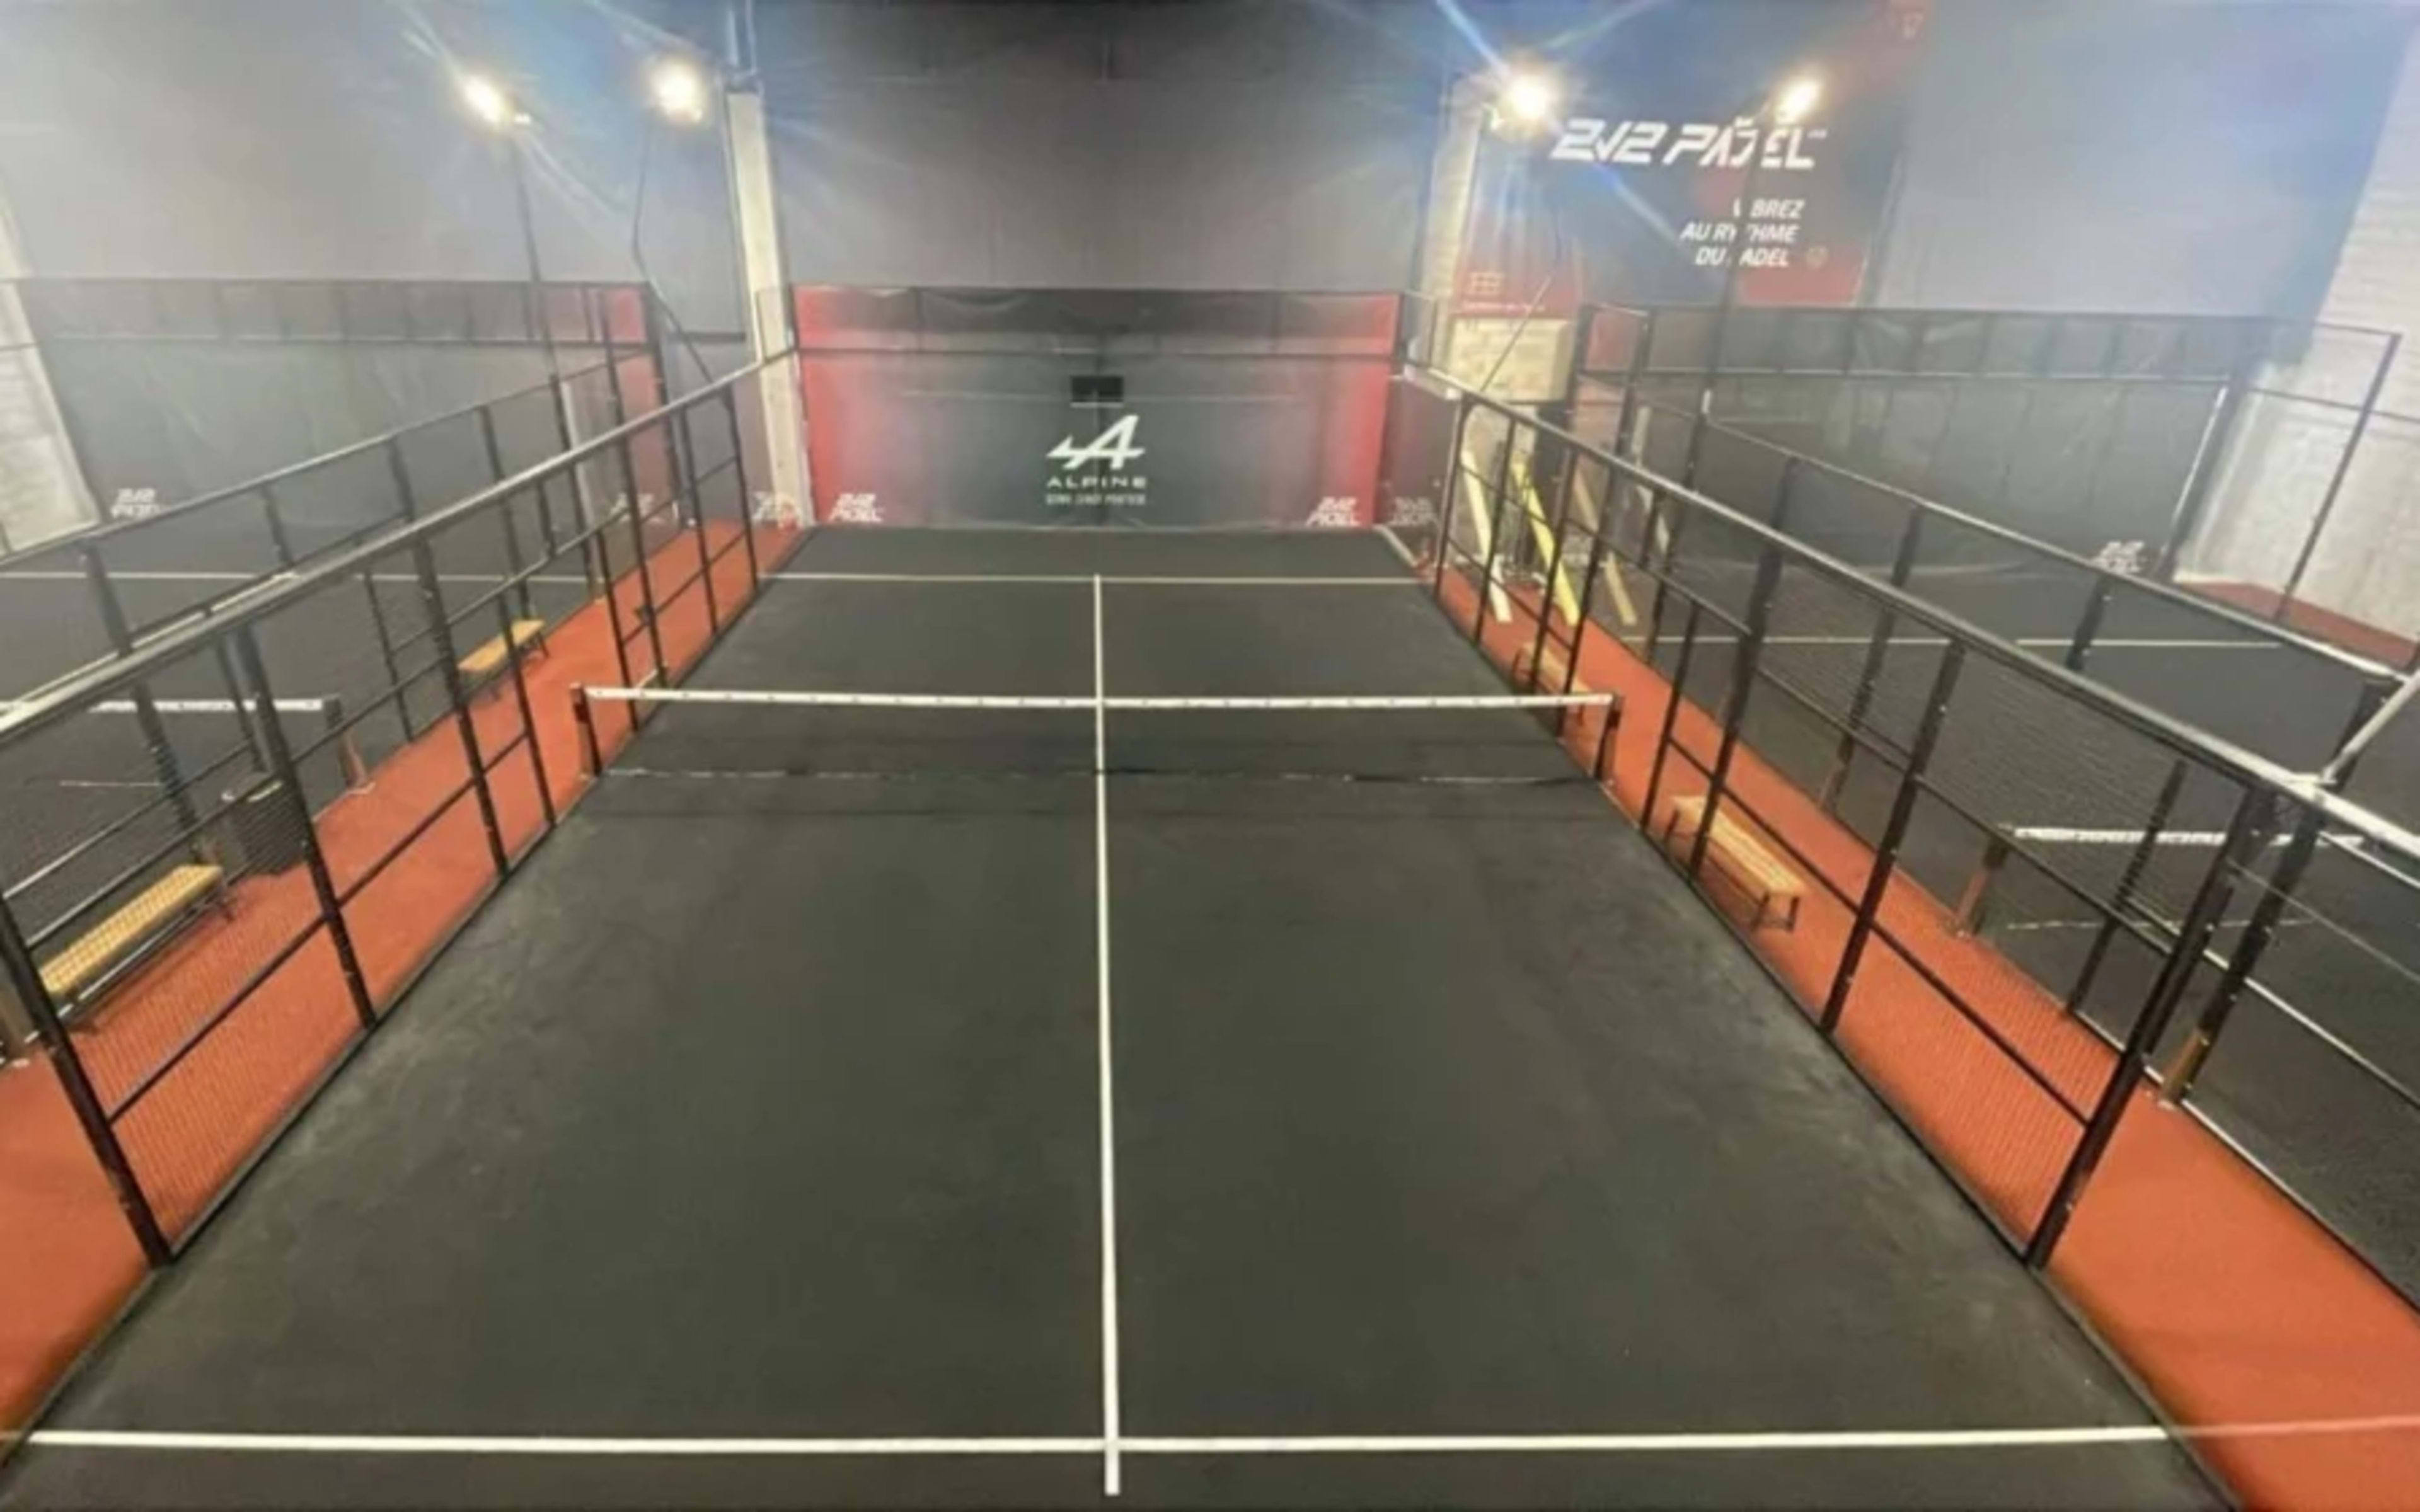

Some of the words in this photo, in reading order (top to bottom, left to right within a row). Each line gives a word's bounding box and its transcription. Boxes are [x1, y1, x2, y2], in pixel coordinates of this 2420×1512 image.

[1734, 198, 1805, 219] BREZ
[1680, 222, 1711, 241] AU
[1695, 246, 1727, 266] DU
[1725, 246, 1789, 268] ADEL
[1046, 476, 1146, 488] ALPINE
